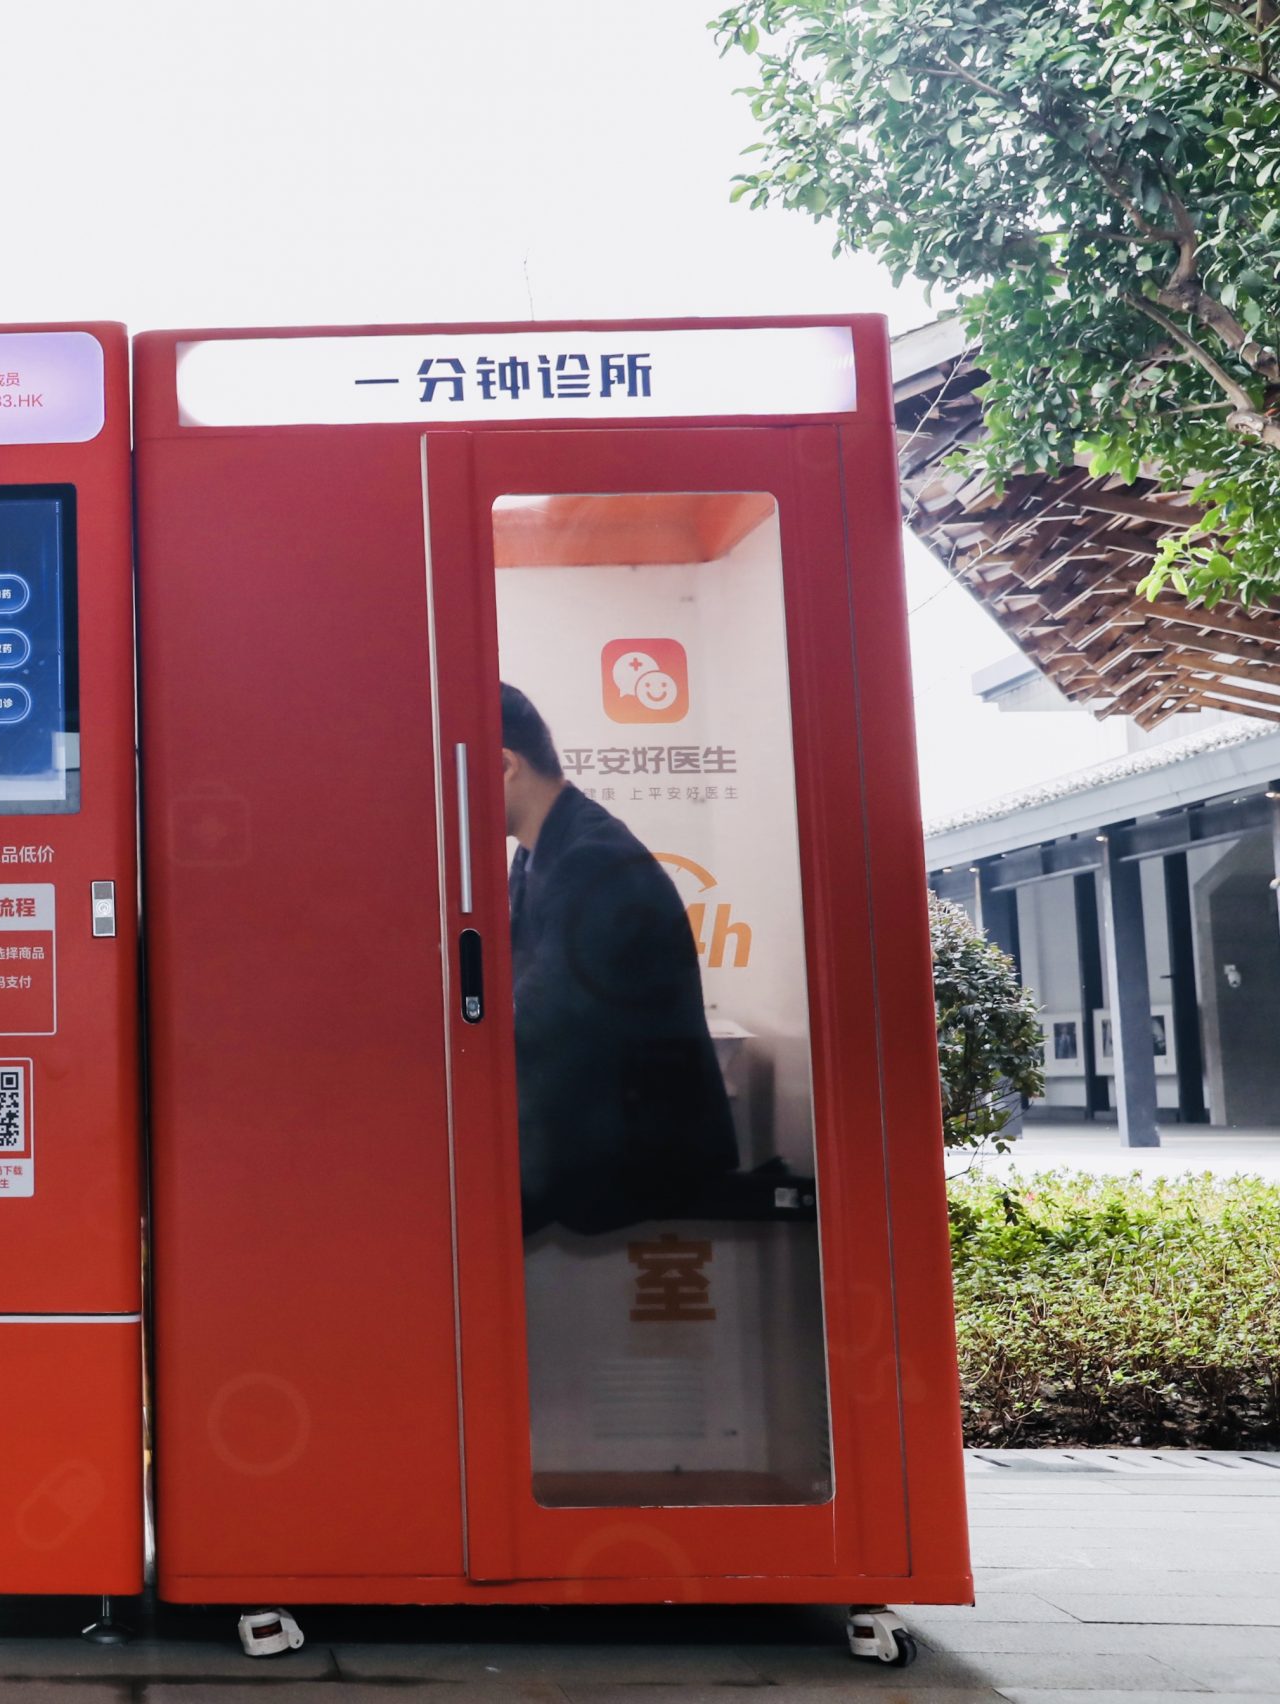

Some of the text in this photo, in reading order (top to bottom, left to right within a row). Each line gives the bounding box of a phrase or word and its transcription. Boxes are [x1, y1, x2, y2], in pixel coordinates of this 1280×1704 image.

[354, 353, 652, 402] 一分钟诊所
[562, 746, 738, 775] 平安好医生
[630, 786, 739, 801] 上平安好医生
[628, 1233, 716, 1322] 室
